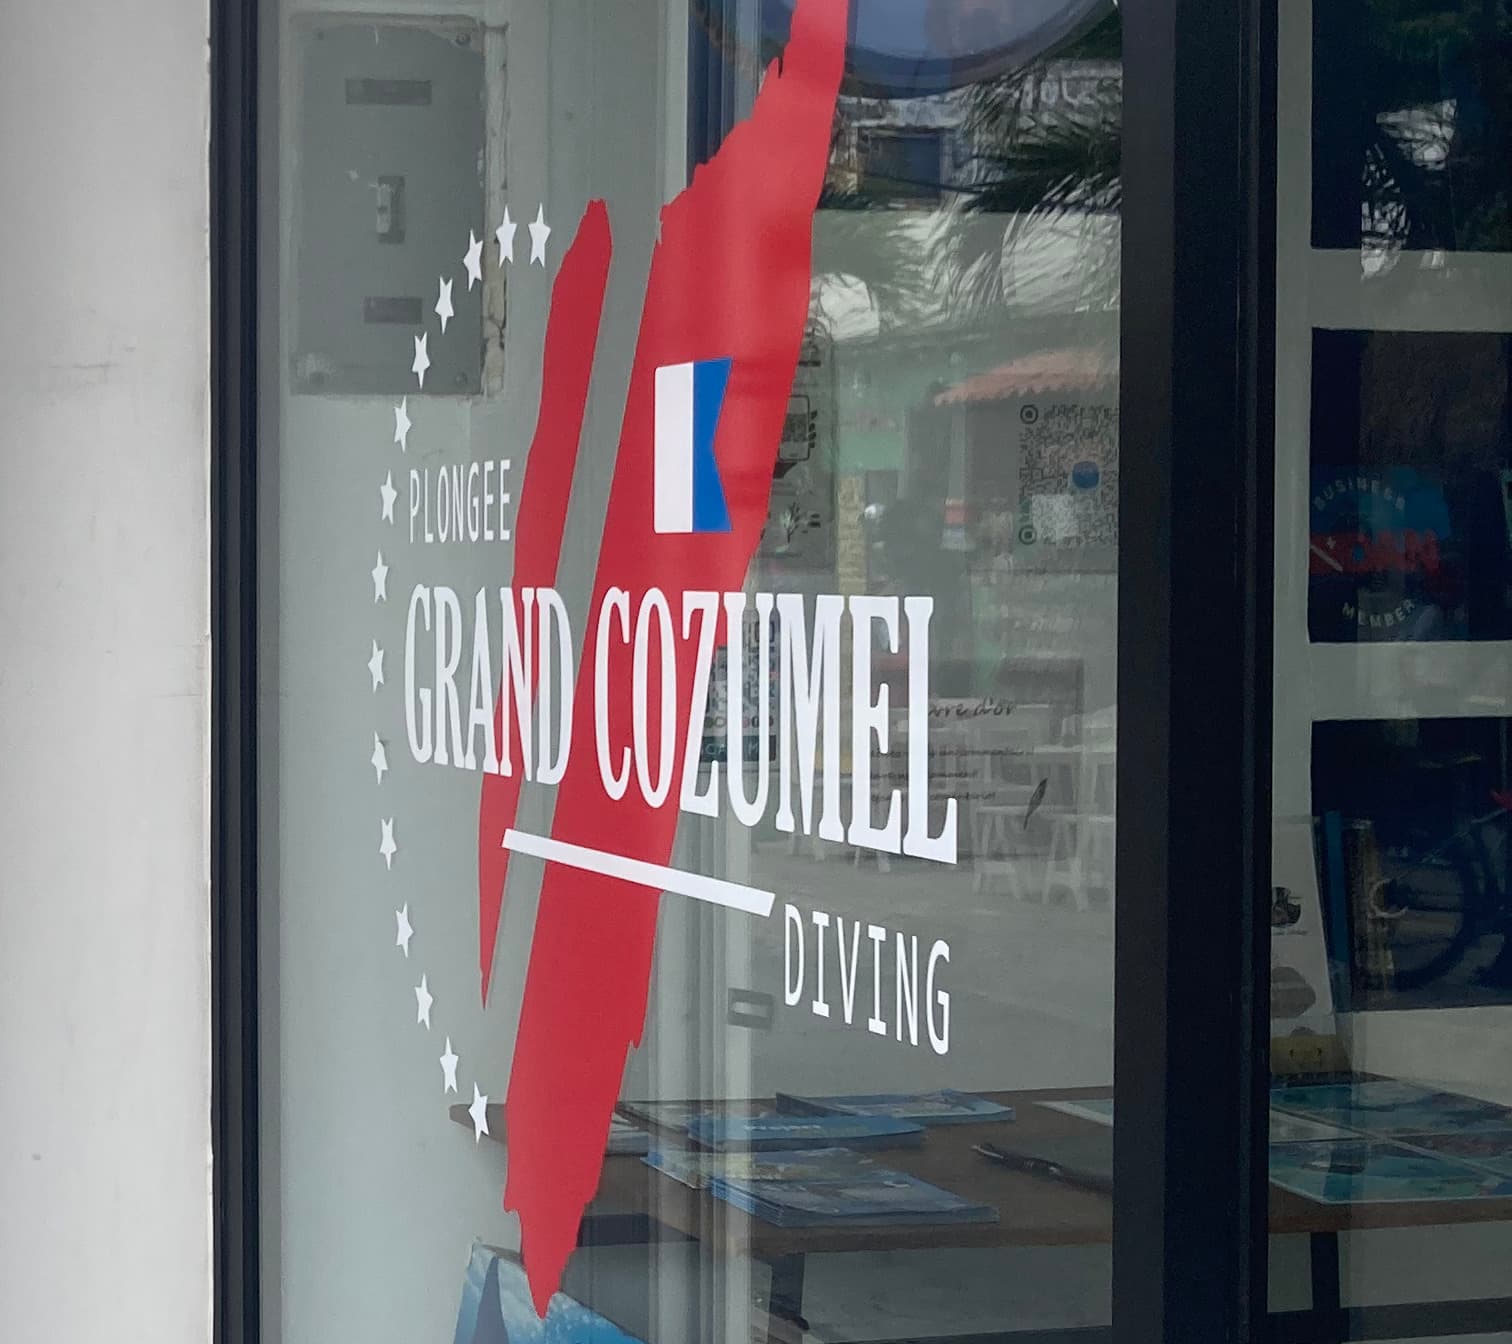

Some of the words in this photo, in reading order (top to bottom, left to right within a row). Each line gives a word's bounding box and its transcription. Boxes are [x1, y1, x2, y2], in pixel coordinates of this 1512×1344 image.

[410, 459, 510, 544] PLONGEE
[1342, 598, 1416, 627] MEMBER
[404, 583, 574, 785] GRAND
[594, 586, 958, 864] COZUMEL
[784, 903, 952, 1056] DIVING
